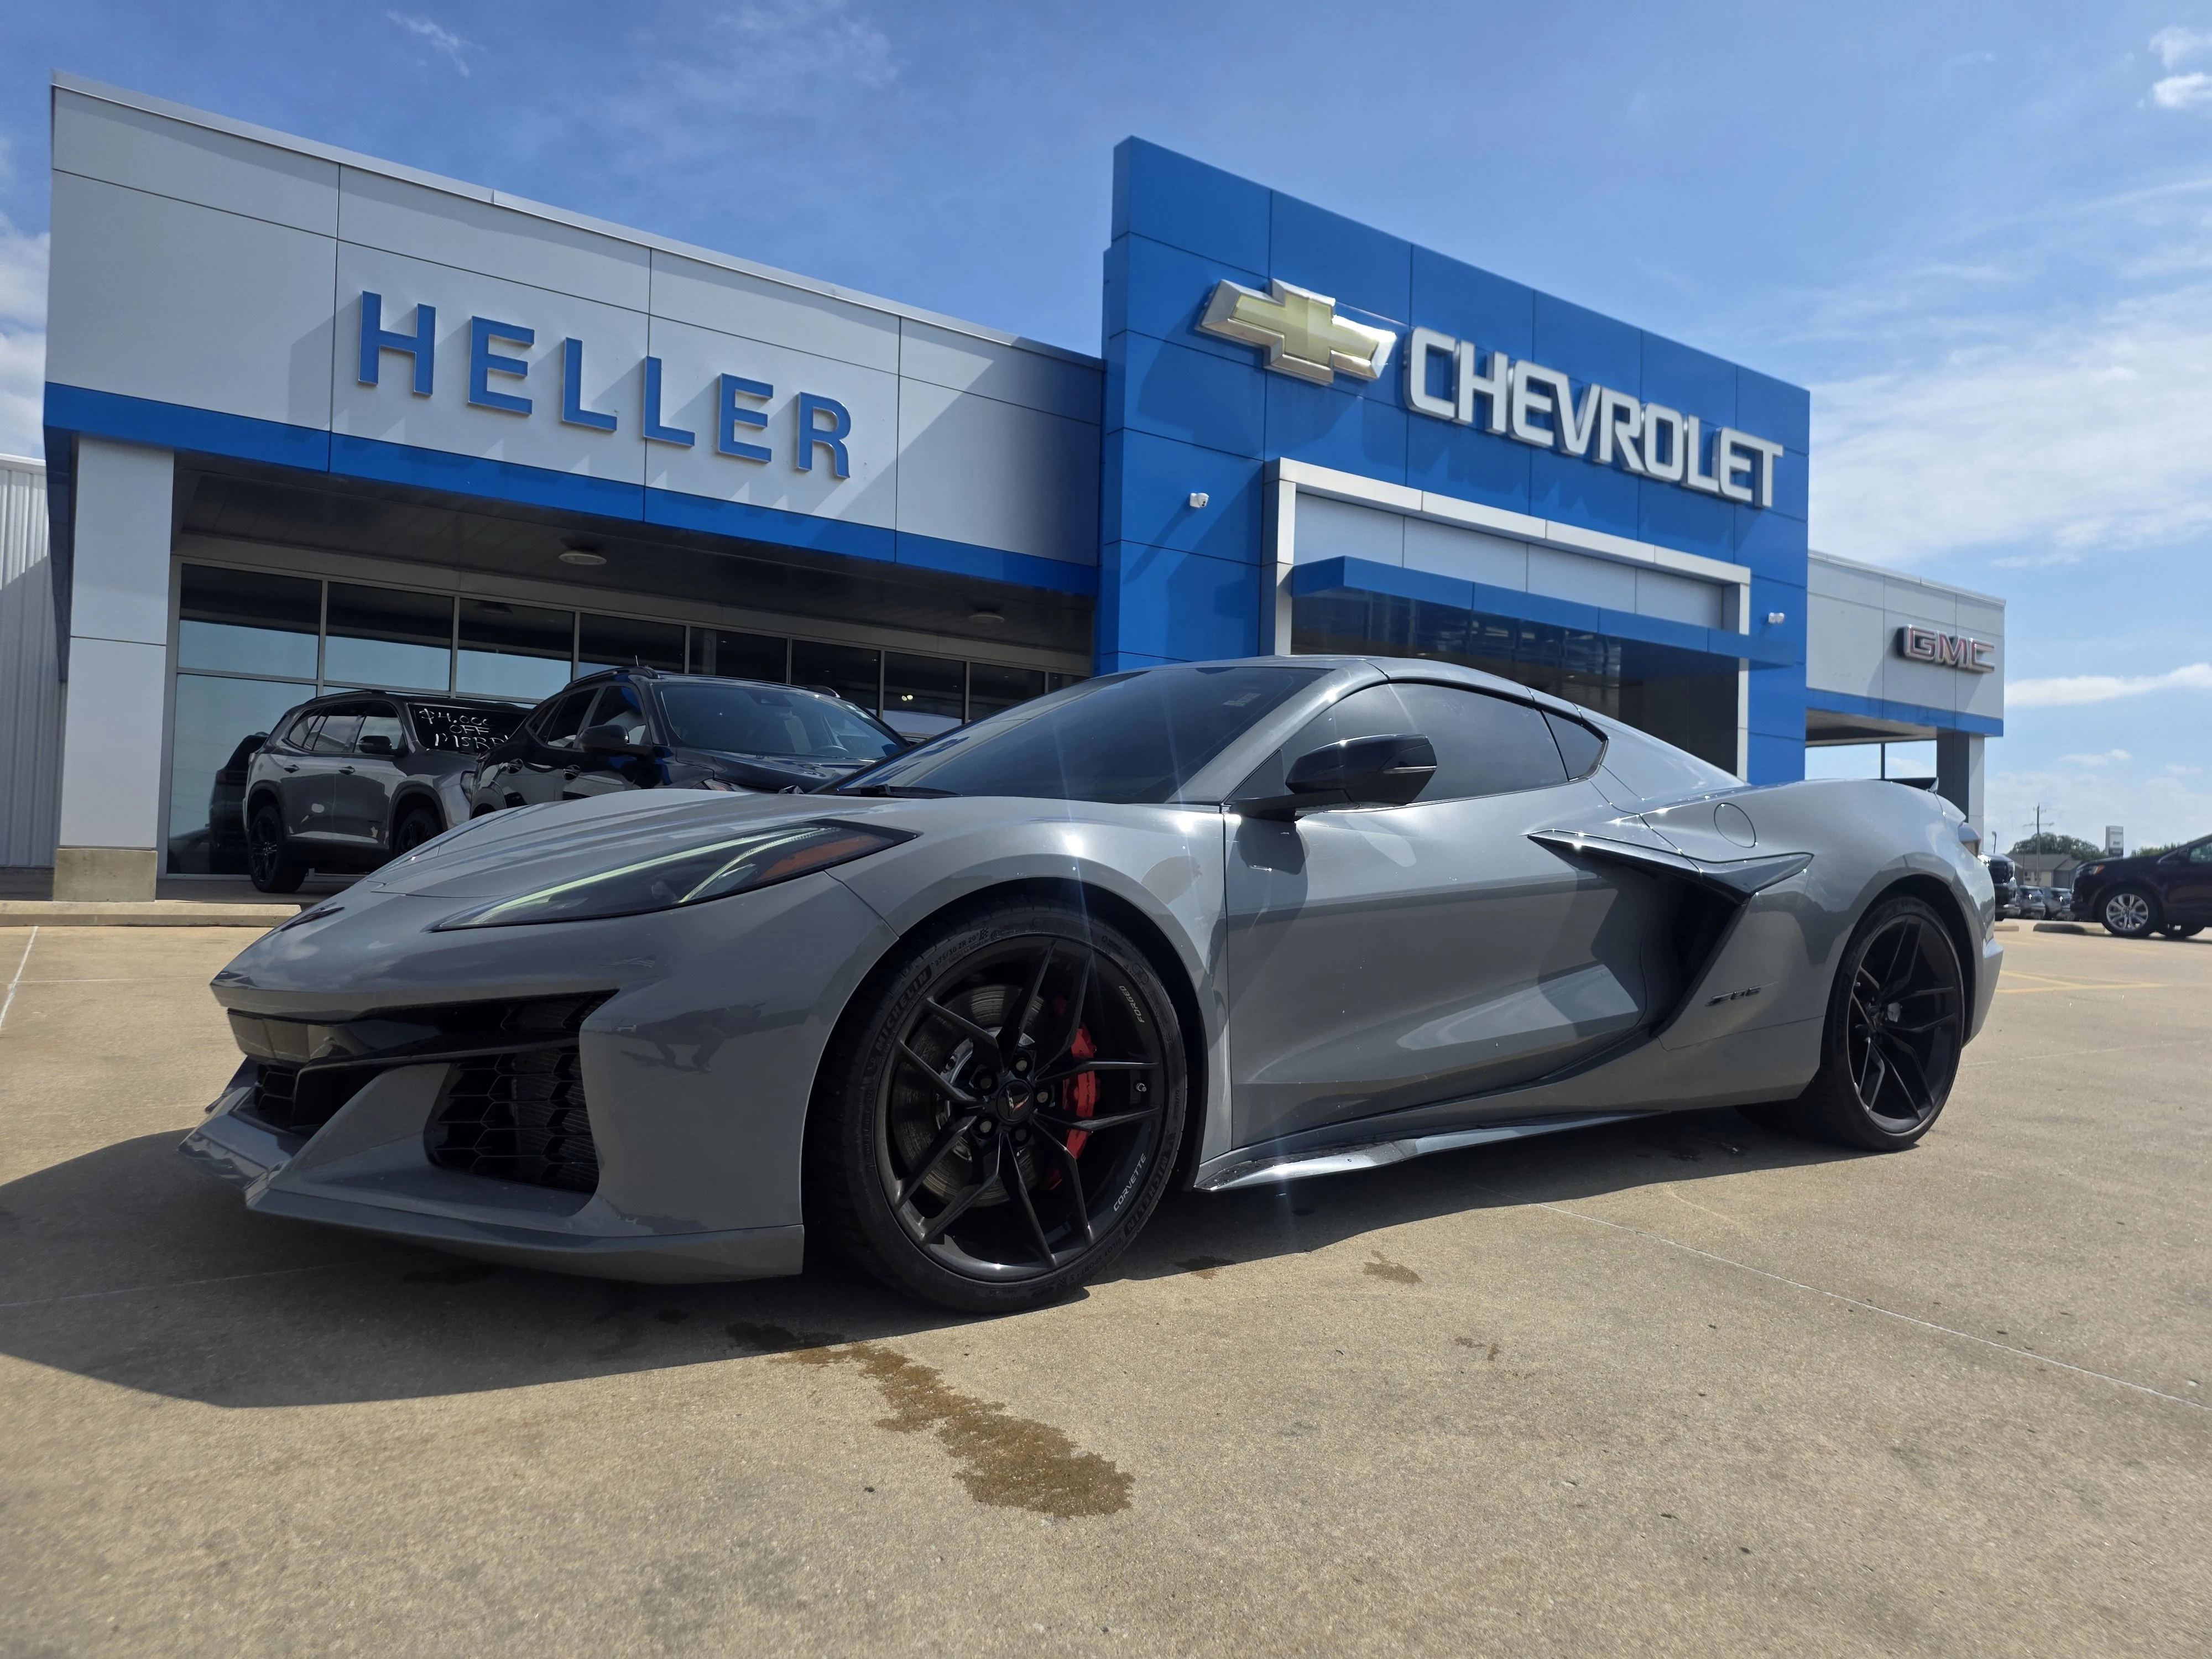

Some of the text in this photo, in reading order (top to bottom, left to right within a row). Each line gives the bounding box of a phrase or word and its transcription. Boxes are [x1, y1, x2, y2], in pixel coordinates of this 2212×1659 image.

[358, 290, 852, 479] HELLER
[1404, 326, 1784, 509] CHEVROLET
[1903, 624, 1996, 674] GMC
[449, 724, 491, 735] OFF
[874, 970, 928, 1052] MICHELIN
[1119, 985, 1145, 1023] FORGED
[1113, 1152, 1146, 1212] CORVETTE
[1127, 1155, 1169, 1232] MICHELIN
